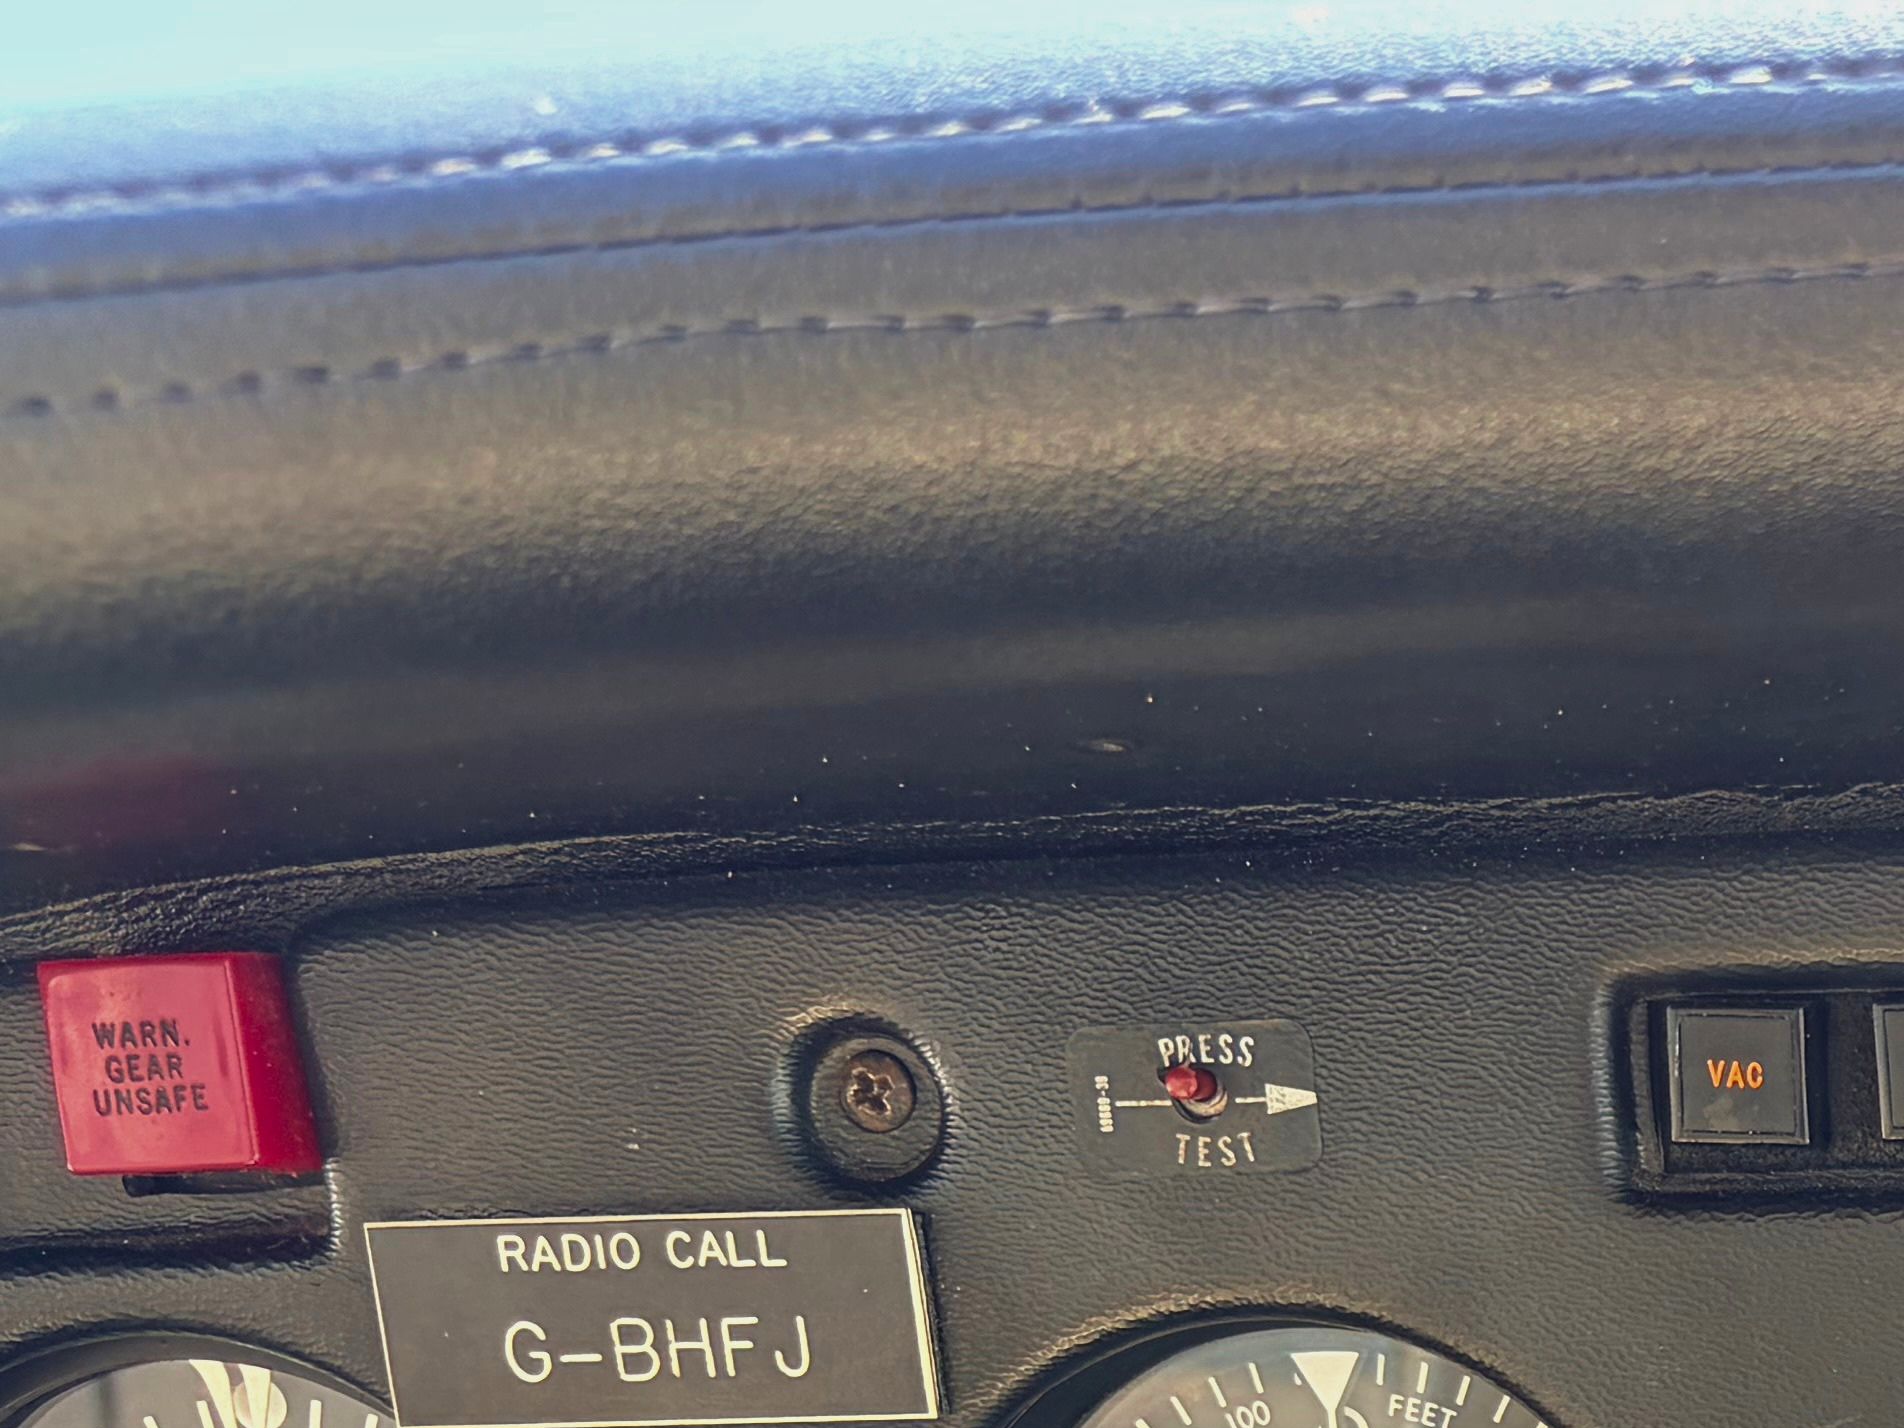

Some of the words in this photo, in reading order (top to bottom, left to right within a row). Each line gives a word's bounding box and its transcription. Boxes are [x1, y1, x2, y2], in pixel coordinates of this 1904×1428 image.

[91, 1021, 191, 1049] WARN.
[1157, 1034, 1255, 1067] PRESS
[104, 1055, 184, 1085] GEAR
[1706, 1058, 1764, 1090] VAC
[93, 1085, 209, 1117] UNSAFE
[1176, 1132, 1256, 1167] TEST
[497, 1232, 641, 1272] RADIO
[667, 1229, 788, 1269] CALL
[504, 1316, 812, 1384] G-BHFJ
